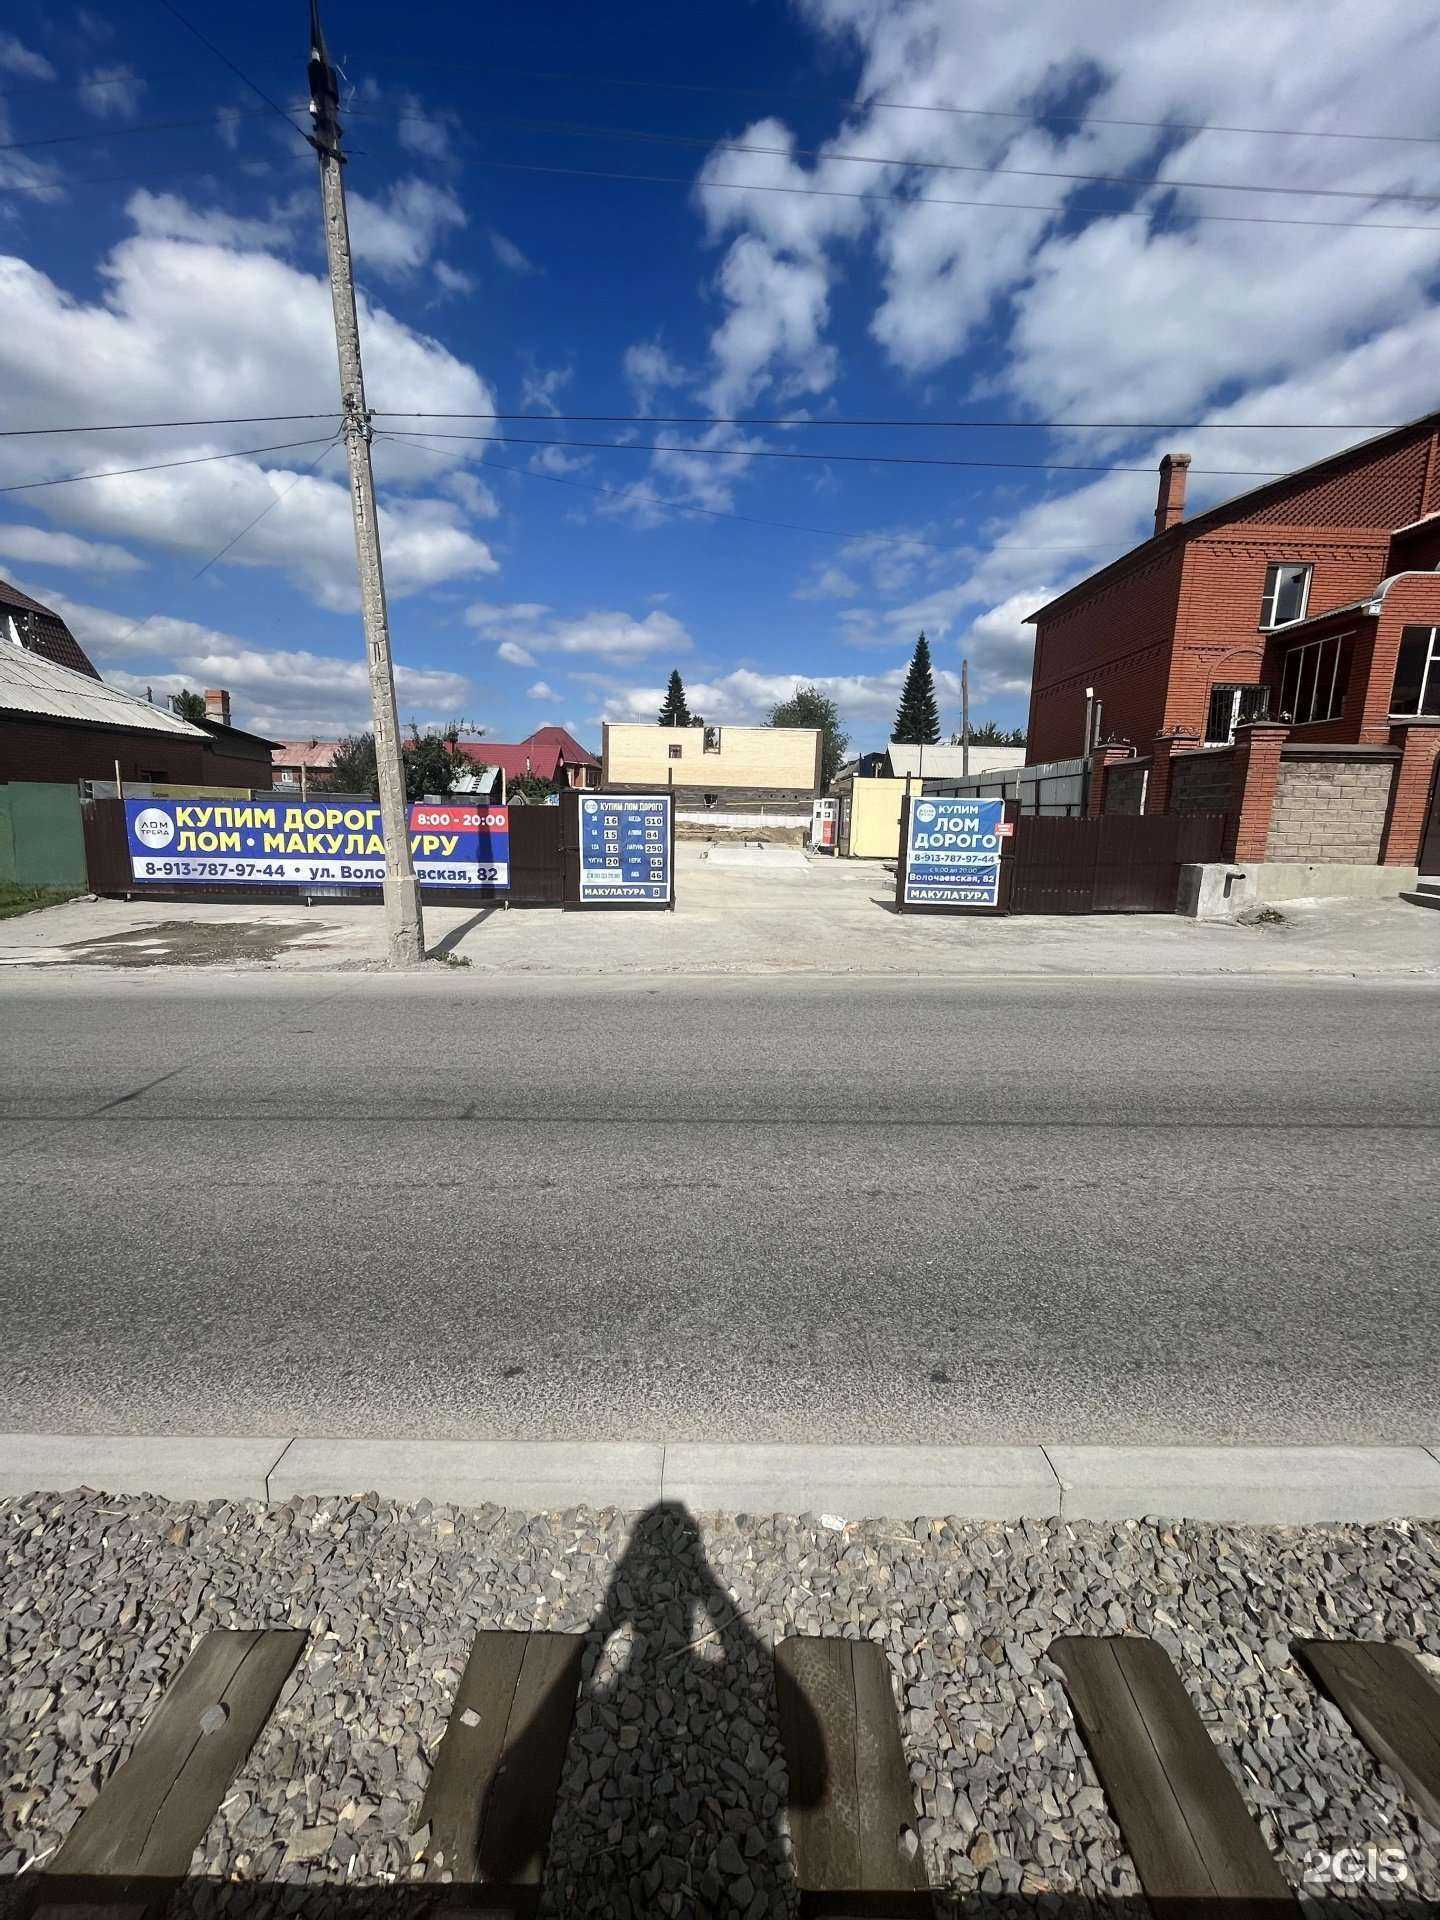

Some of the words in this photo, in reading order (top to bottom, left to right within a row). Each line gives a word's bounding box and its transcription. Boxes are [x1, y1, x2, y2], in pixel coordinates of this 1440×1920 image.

[938, 805, 979, 814] КУПИМ
[175, 807, 276, 829] КУПИМ
[284, 808, 405, 832] ДОРОГ
[417, 814, 450, 826] 8:00
[463, 814, 506, 826] 20:00
[605, 817, 617, 825] 16
[934, 817, 979, 832] ЛОМ
[141, 821, 168, 829] ЛОМ
[605, 831, 617, 839] 15
[177, 831, 241, 852] ЛОМ
[263, 832, 459, 856] МАКУЛАУРУ
[914, 833, 997, 849] ДОРОГО
[914, 854, 995, 863] 8-913-787-97-44
[145, 862, 286, 877] 8-913-787-97-44
[309, 867, 336, 881] ул.
[340, 866, 472, 883] Воловская,
[477, 868, 498, 881] 82
[909, 873, 980, 883] Волочаевская,
[983, 875, 995, 883] 82
[584, 888, 646, 896] МАКУЛАТУРА
[910, 890, 990, 900] МАКУЛАТУРА
